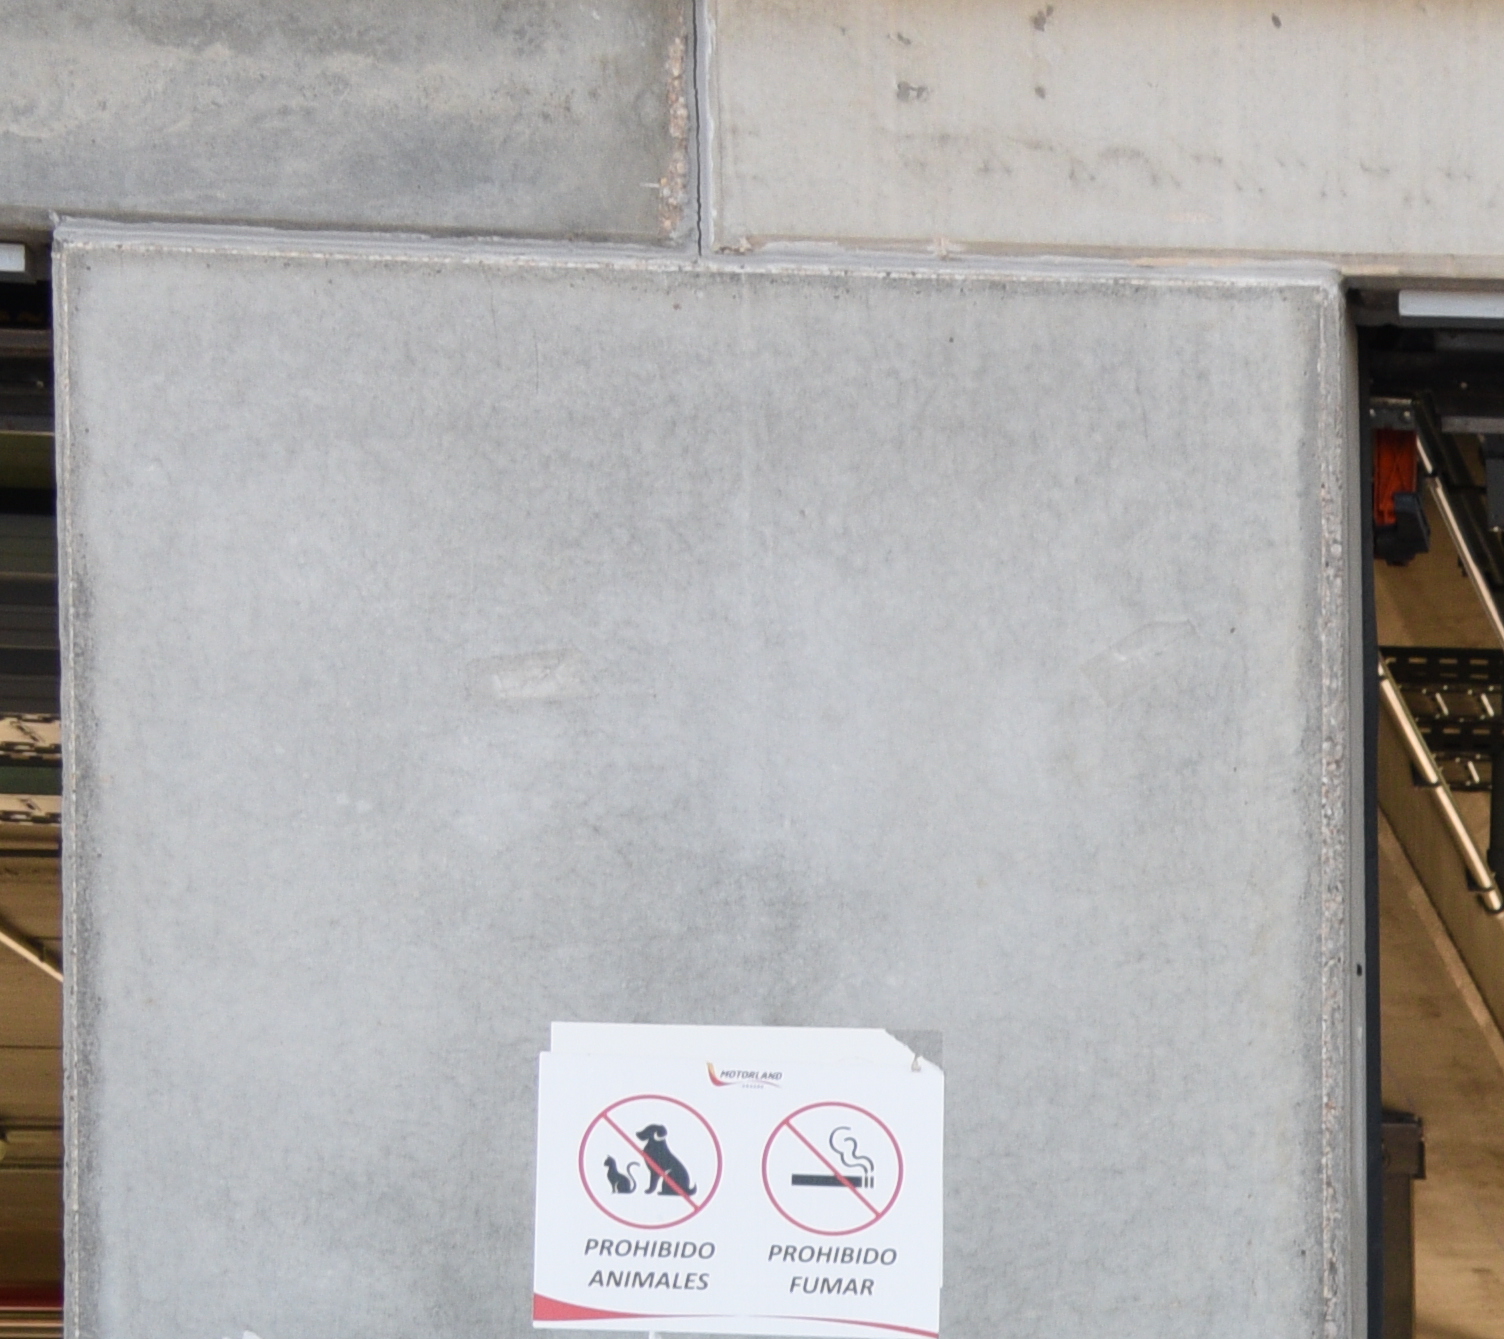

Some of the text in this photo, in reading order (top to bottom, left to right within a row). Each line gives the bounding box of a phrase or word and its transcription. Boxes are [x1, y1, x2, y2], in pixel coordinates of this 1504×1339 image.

[584, 1239, 715, 1260] PROHIBIDO
[768, 1245, 898, 1266] PROHIBIDO
[588, 1270, 710, 1291] ANIMALES
[789, 1276, 875, 1296] FUMAR
